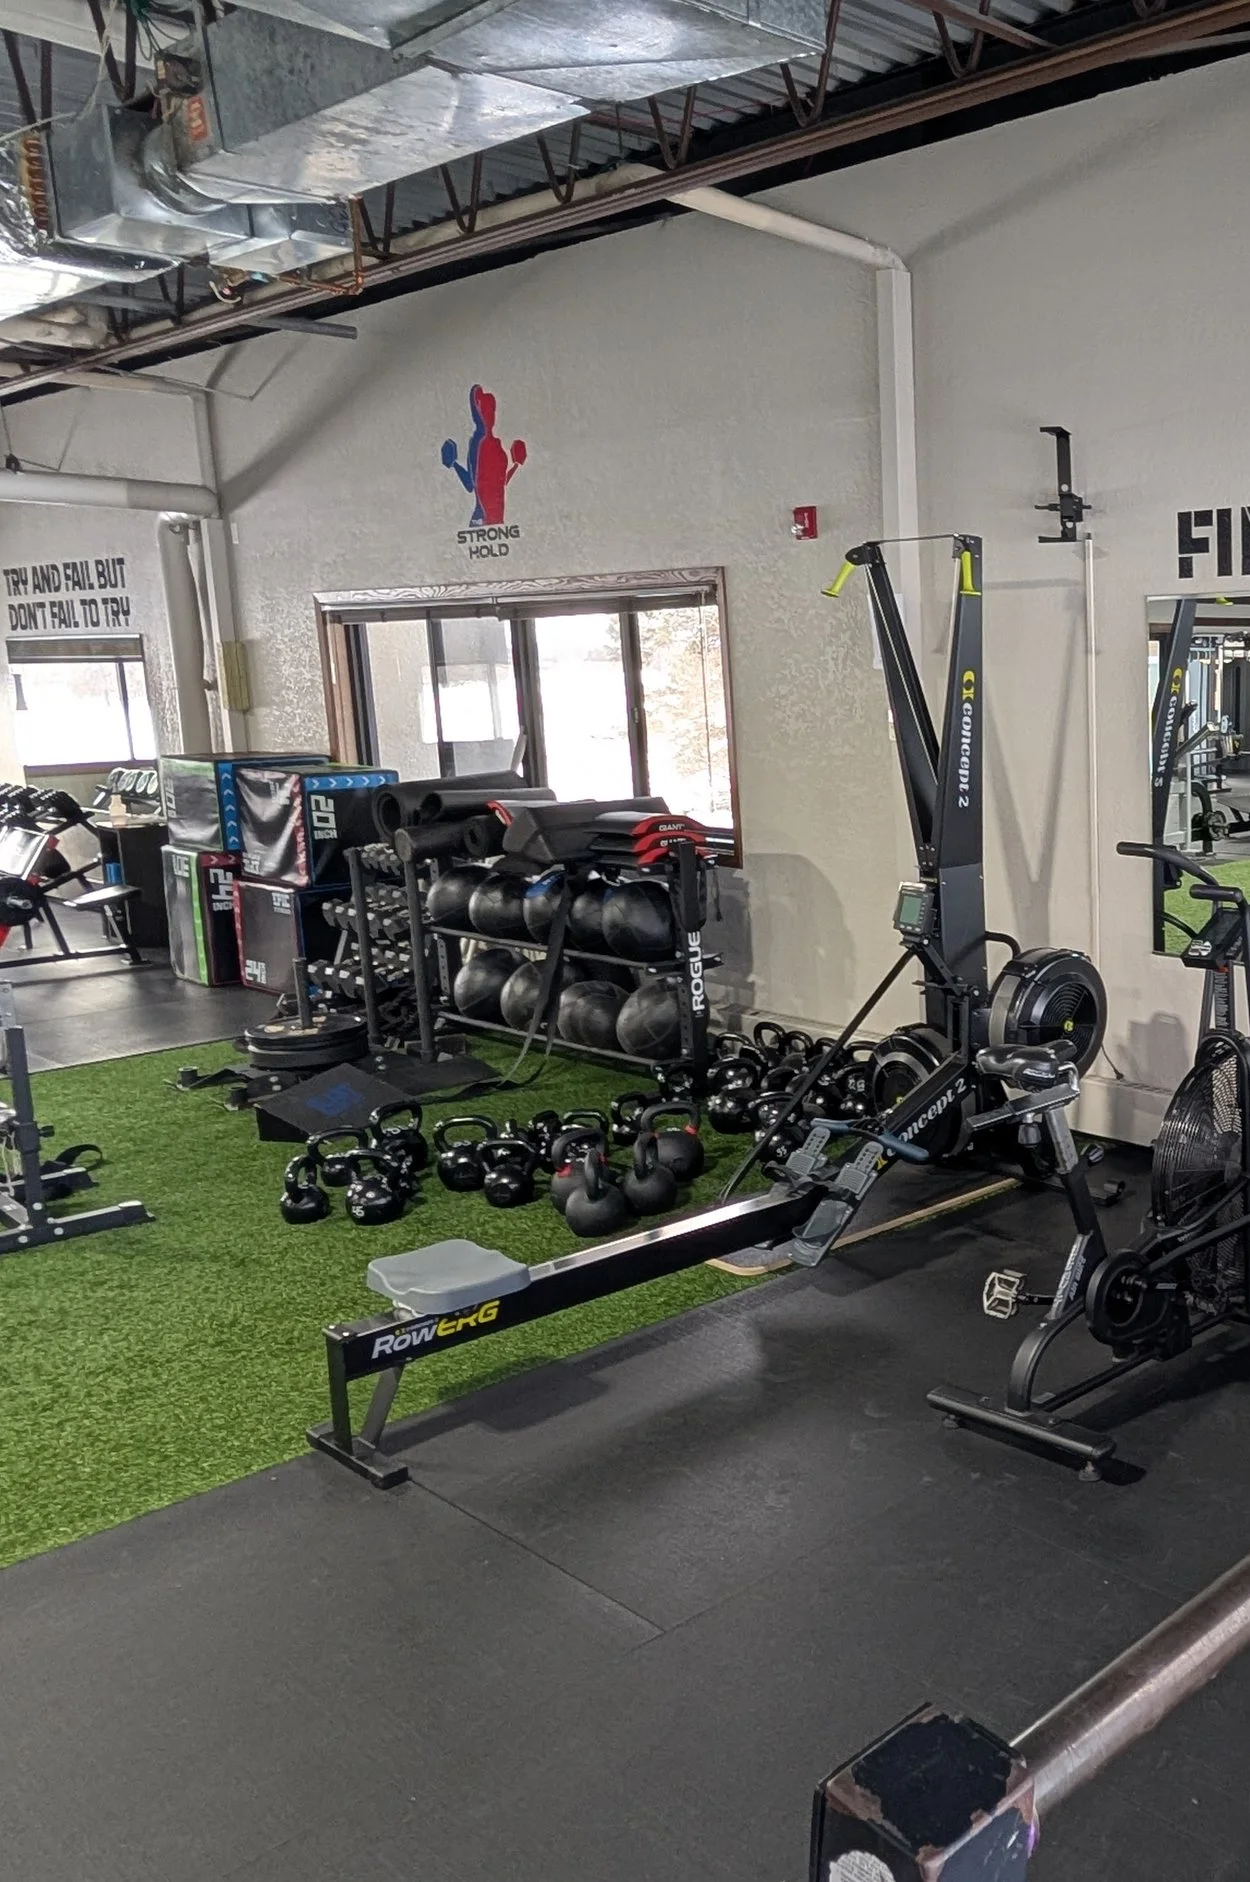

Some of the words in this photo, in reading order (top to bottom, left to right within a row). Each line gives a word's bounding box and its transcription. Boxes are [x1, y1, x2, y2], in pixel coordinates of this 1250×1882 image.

[457, 525, 520, 544] STRONG
[469, 543, 509, 559] HOLD
[3, 567, 28, 596] TRY
[32, 563, 61, 594] AND
[63, 560, 95, 592] FAIL
[95, 557, 126, 589] BUT
[49, 599, 80, 629] FAIL
[79, 598, 100, 628] TO
[101, 596, 130, 627] TRY
[958, 702, 973, 792] concept
[311, 795, 336, 829] 20
[958, 795, 970, 808] 2
[658, 823, 683, 832] GIANT
[209, 868, 235, 901] 24
[688, 930, 706, 1012] ROGUE
[954, 1078, 967, 1094] 2
